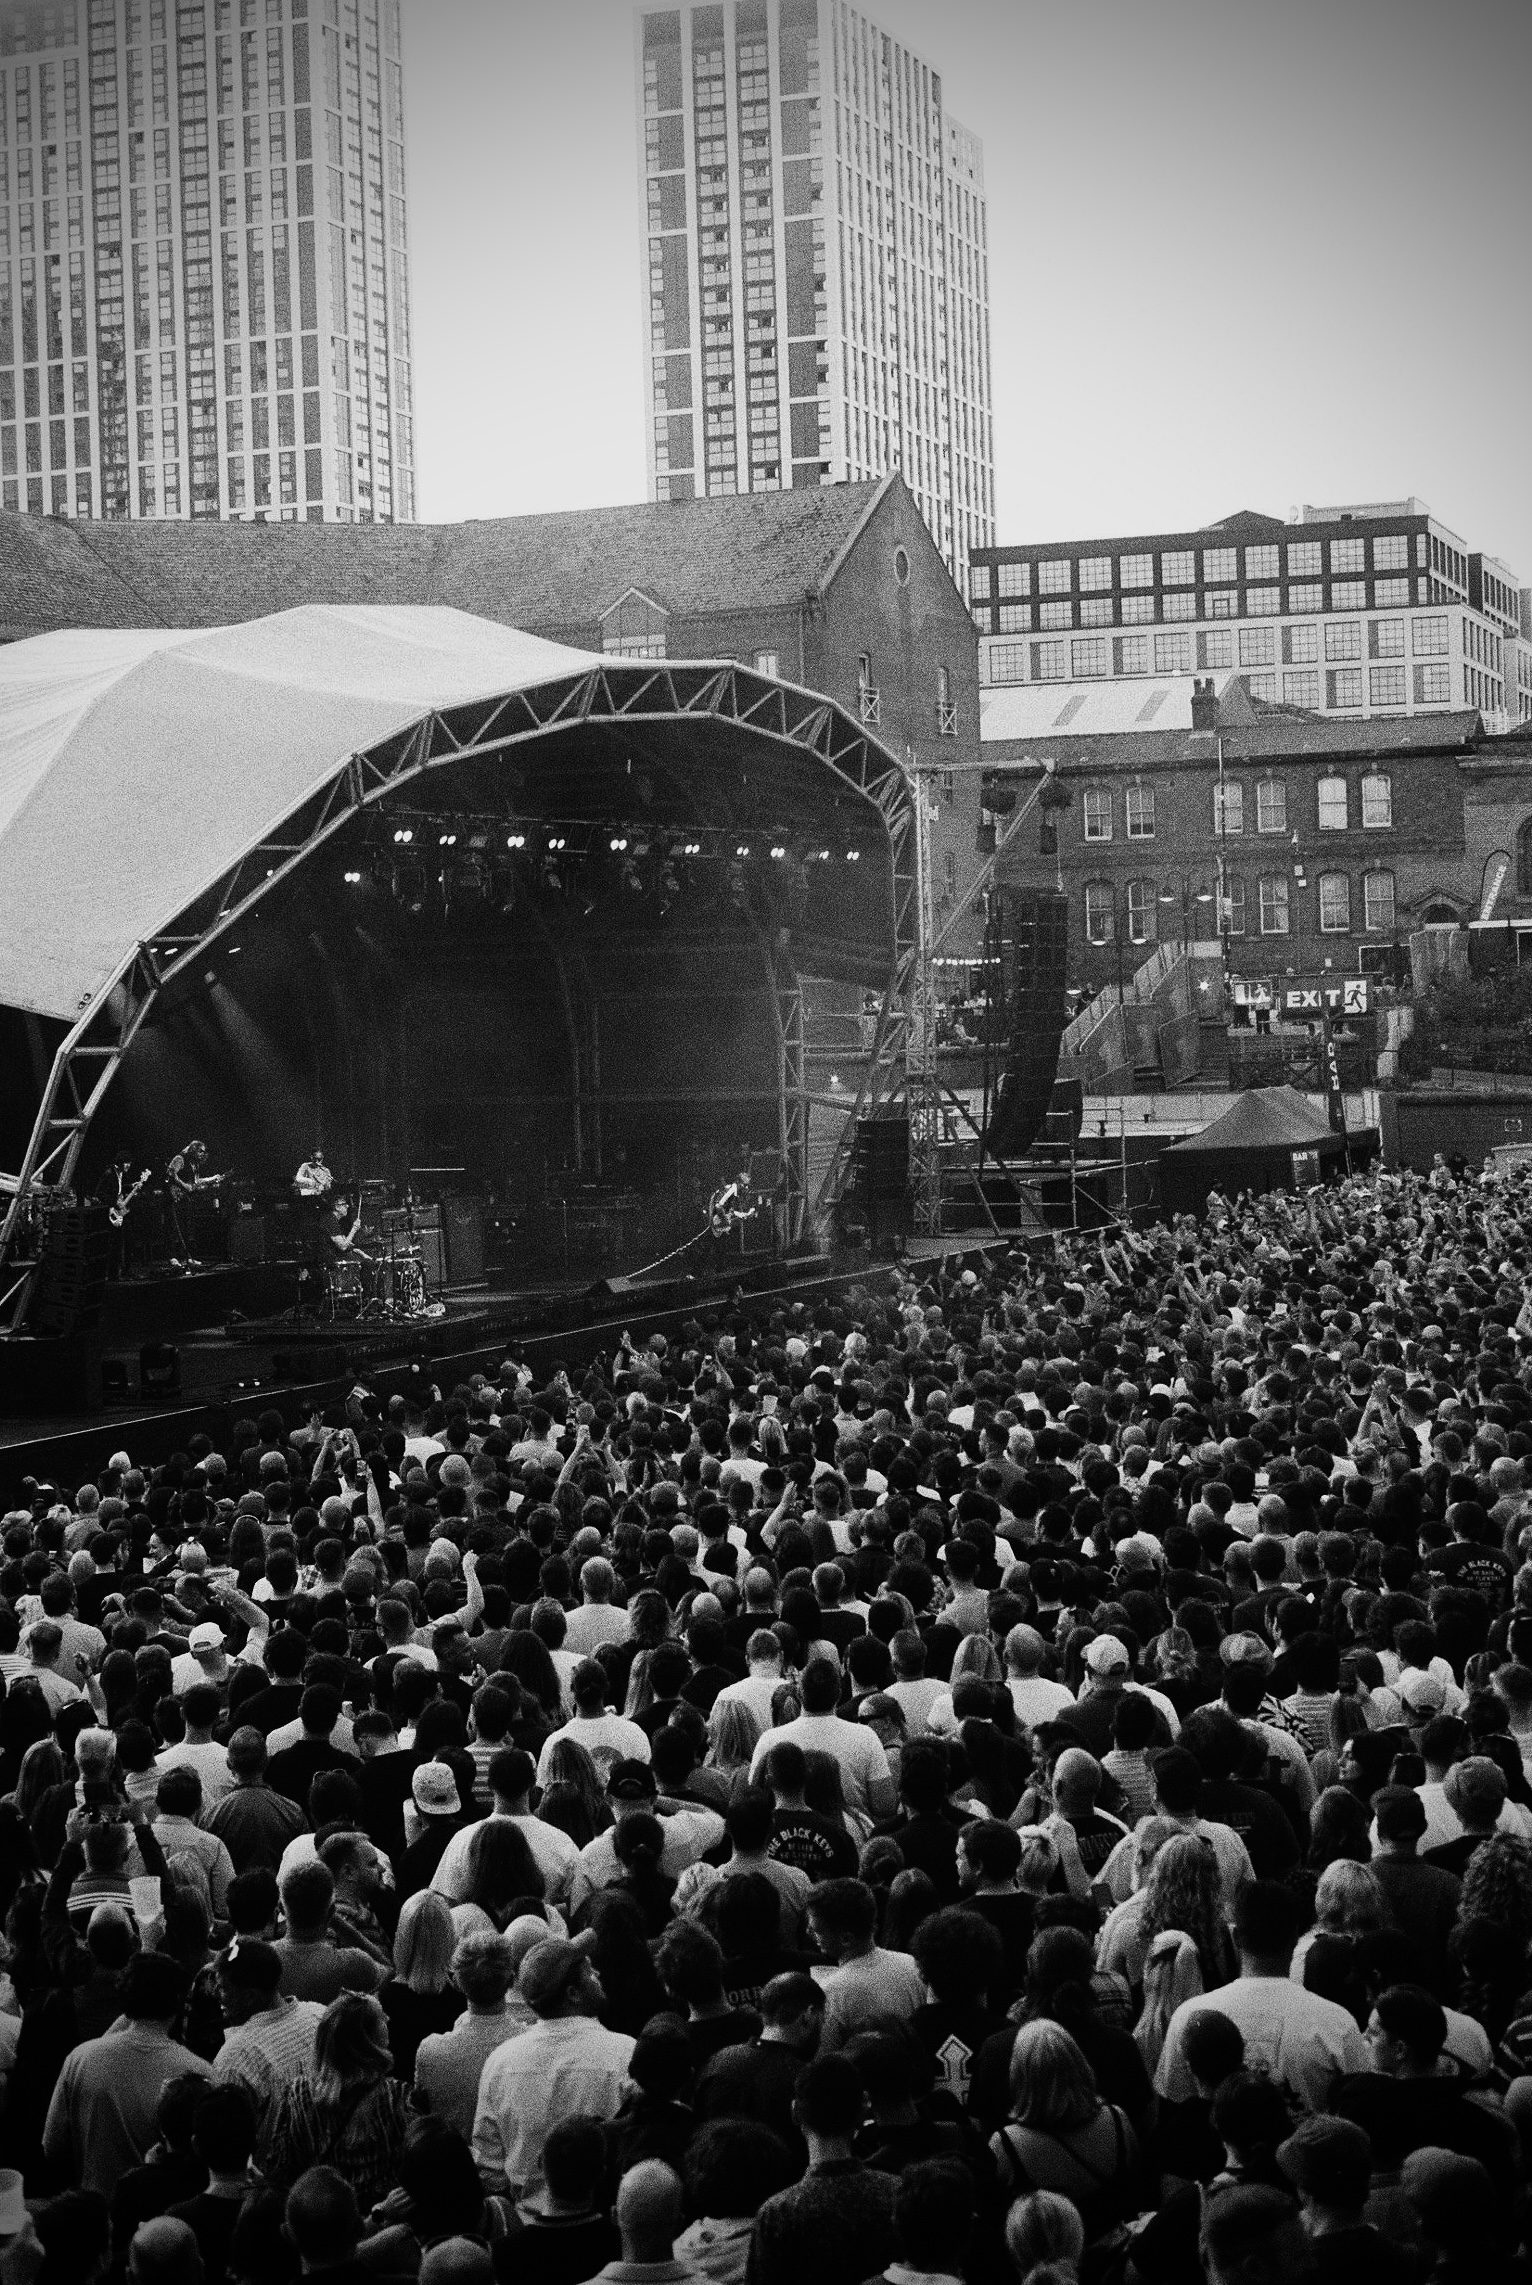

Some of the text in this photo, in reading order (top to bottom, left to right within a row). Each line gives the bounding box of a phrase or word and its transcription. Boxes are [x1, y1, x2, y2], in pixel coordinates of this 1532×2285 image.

[1286, 989, 1341, 1008] EXIT
[780, 1827, 811, 1841] BLACK
[813, 1833, 834, 1858] KEYS
